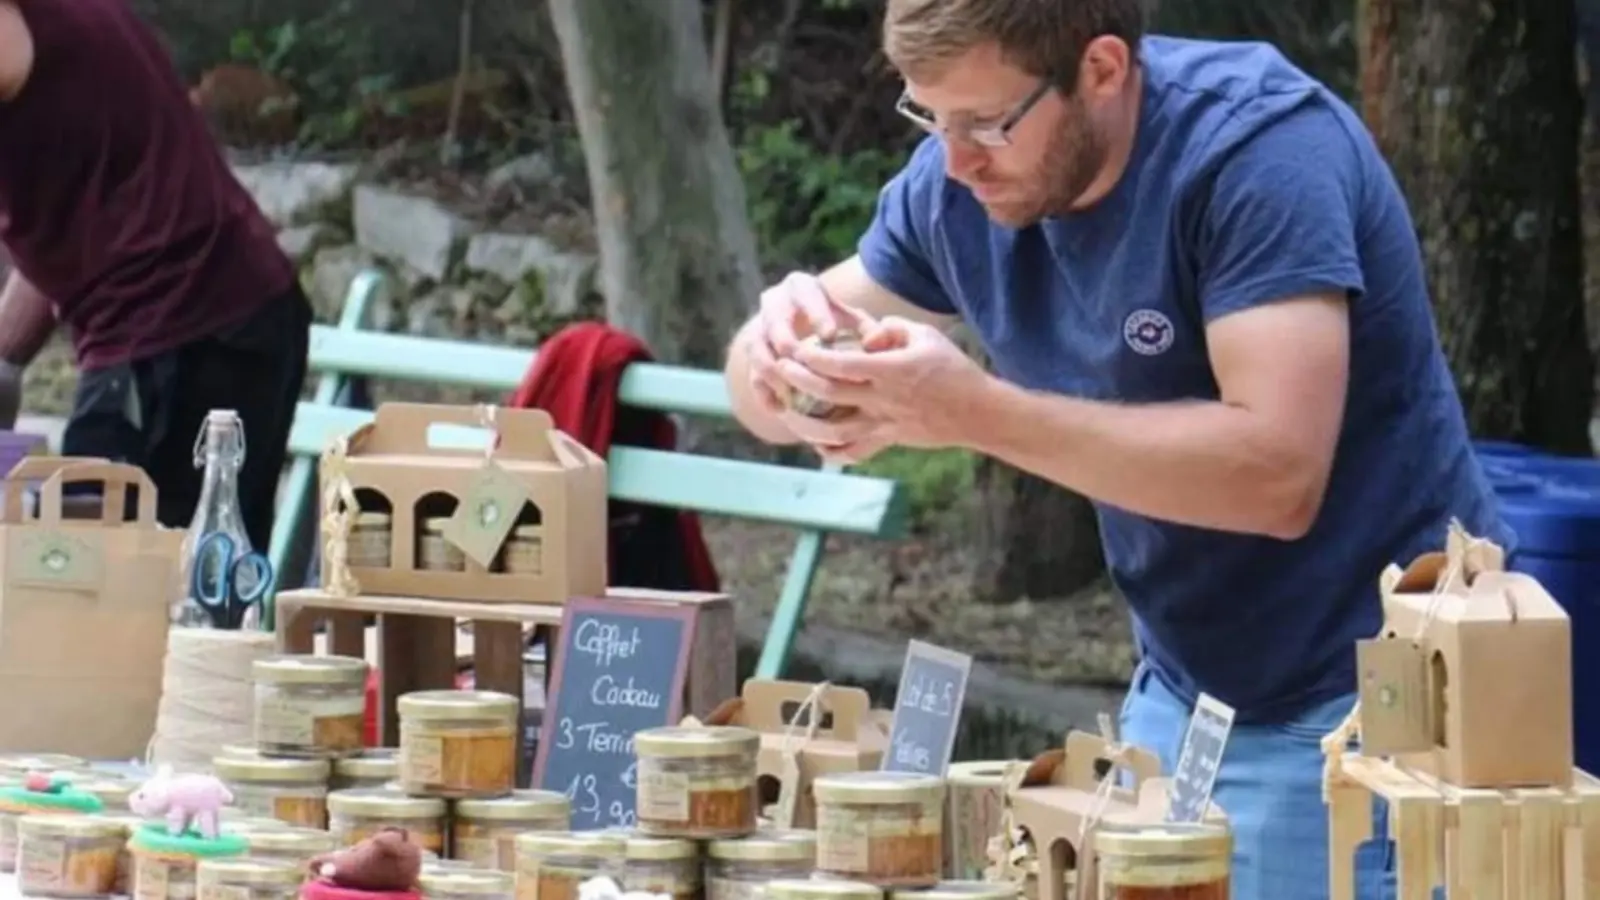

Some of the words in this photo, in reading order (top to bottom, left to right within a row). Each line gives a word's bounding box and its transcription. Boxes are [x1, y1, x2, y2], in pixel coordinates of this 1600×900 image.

[575, 619, 641, 666] Coffret
[591, 675, 661, 708] Cadeau
[556, 717, 575, 750] 3
[576, 722, 636, 754] Terrin
